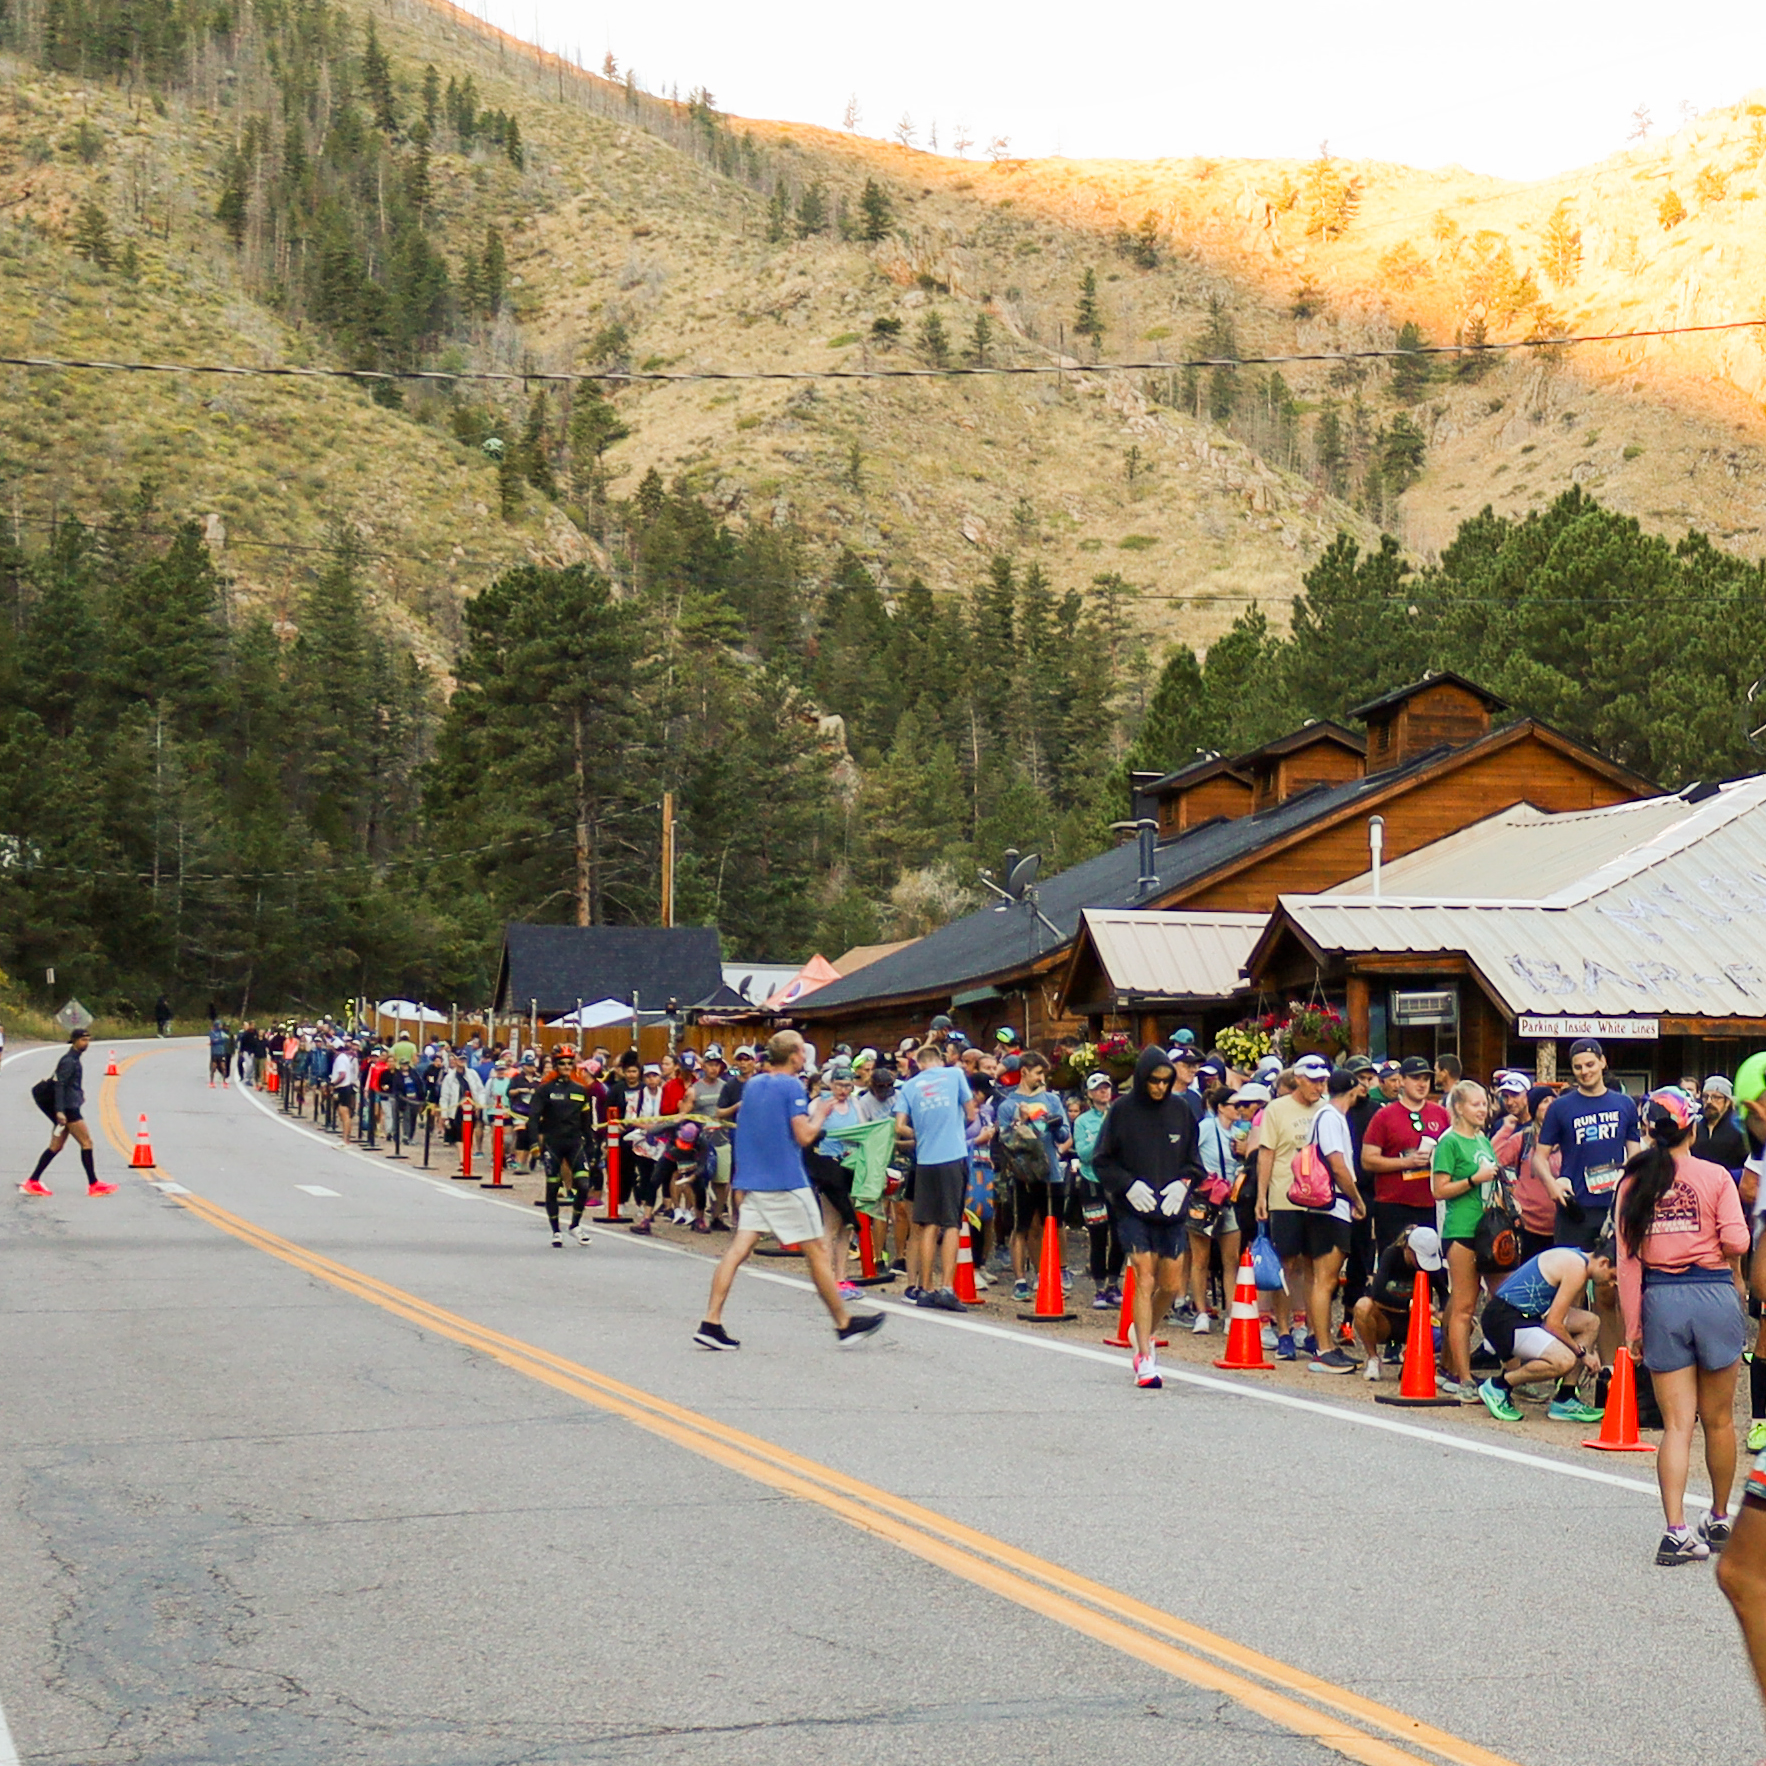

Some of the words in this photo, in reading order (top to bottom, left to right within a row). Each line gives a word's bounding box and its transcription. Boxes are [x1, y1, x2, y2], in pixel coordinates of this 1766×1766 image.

[1521, 1019, 1559, 1036] Parking
[1564, 1019, 1592, 1034] Inside
[1597, 1020, 1626, 1034] White
[1631, 1020, 1656, 1034] Lines
[1573, 1113, 1598, 1129] RUN
[1598, 1110, 1620, 1123] THE
